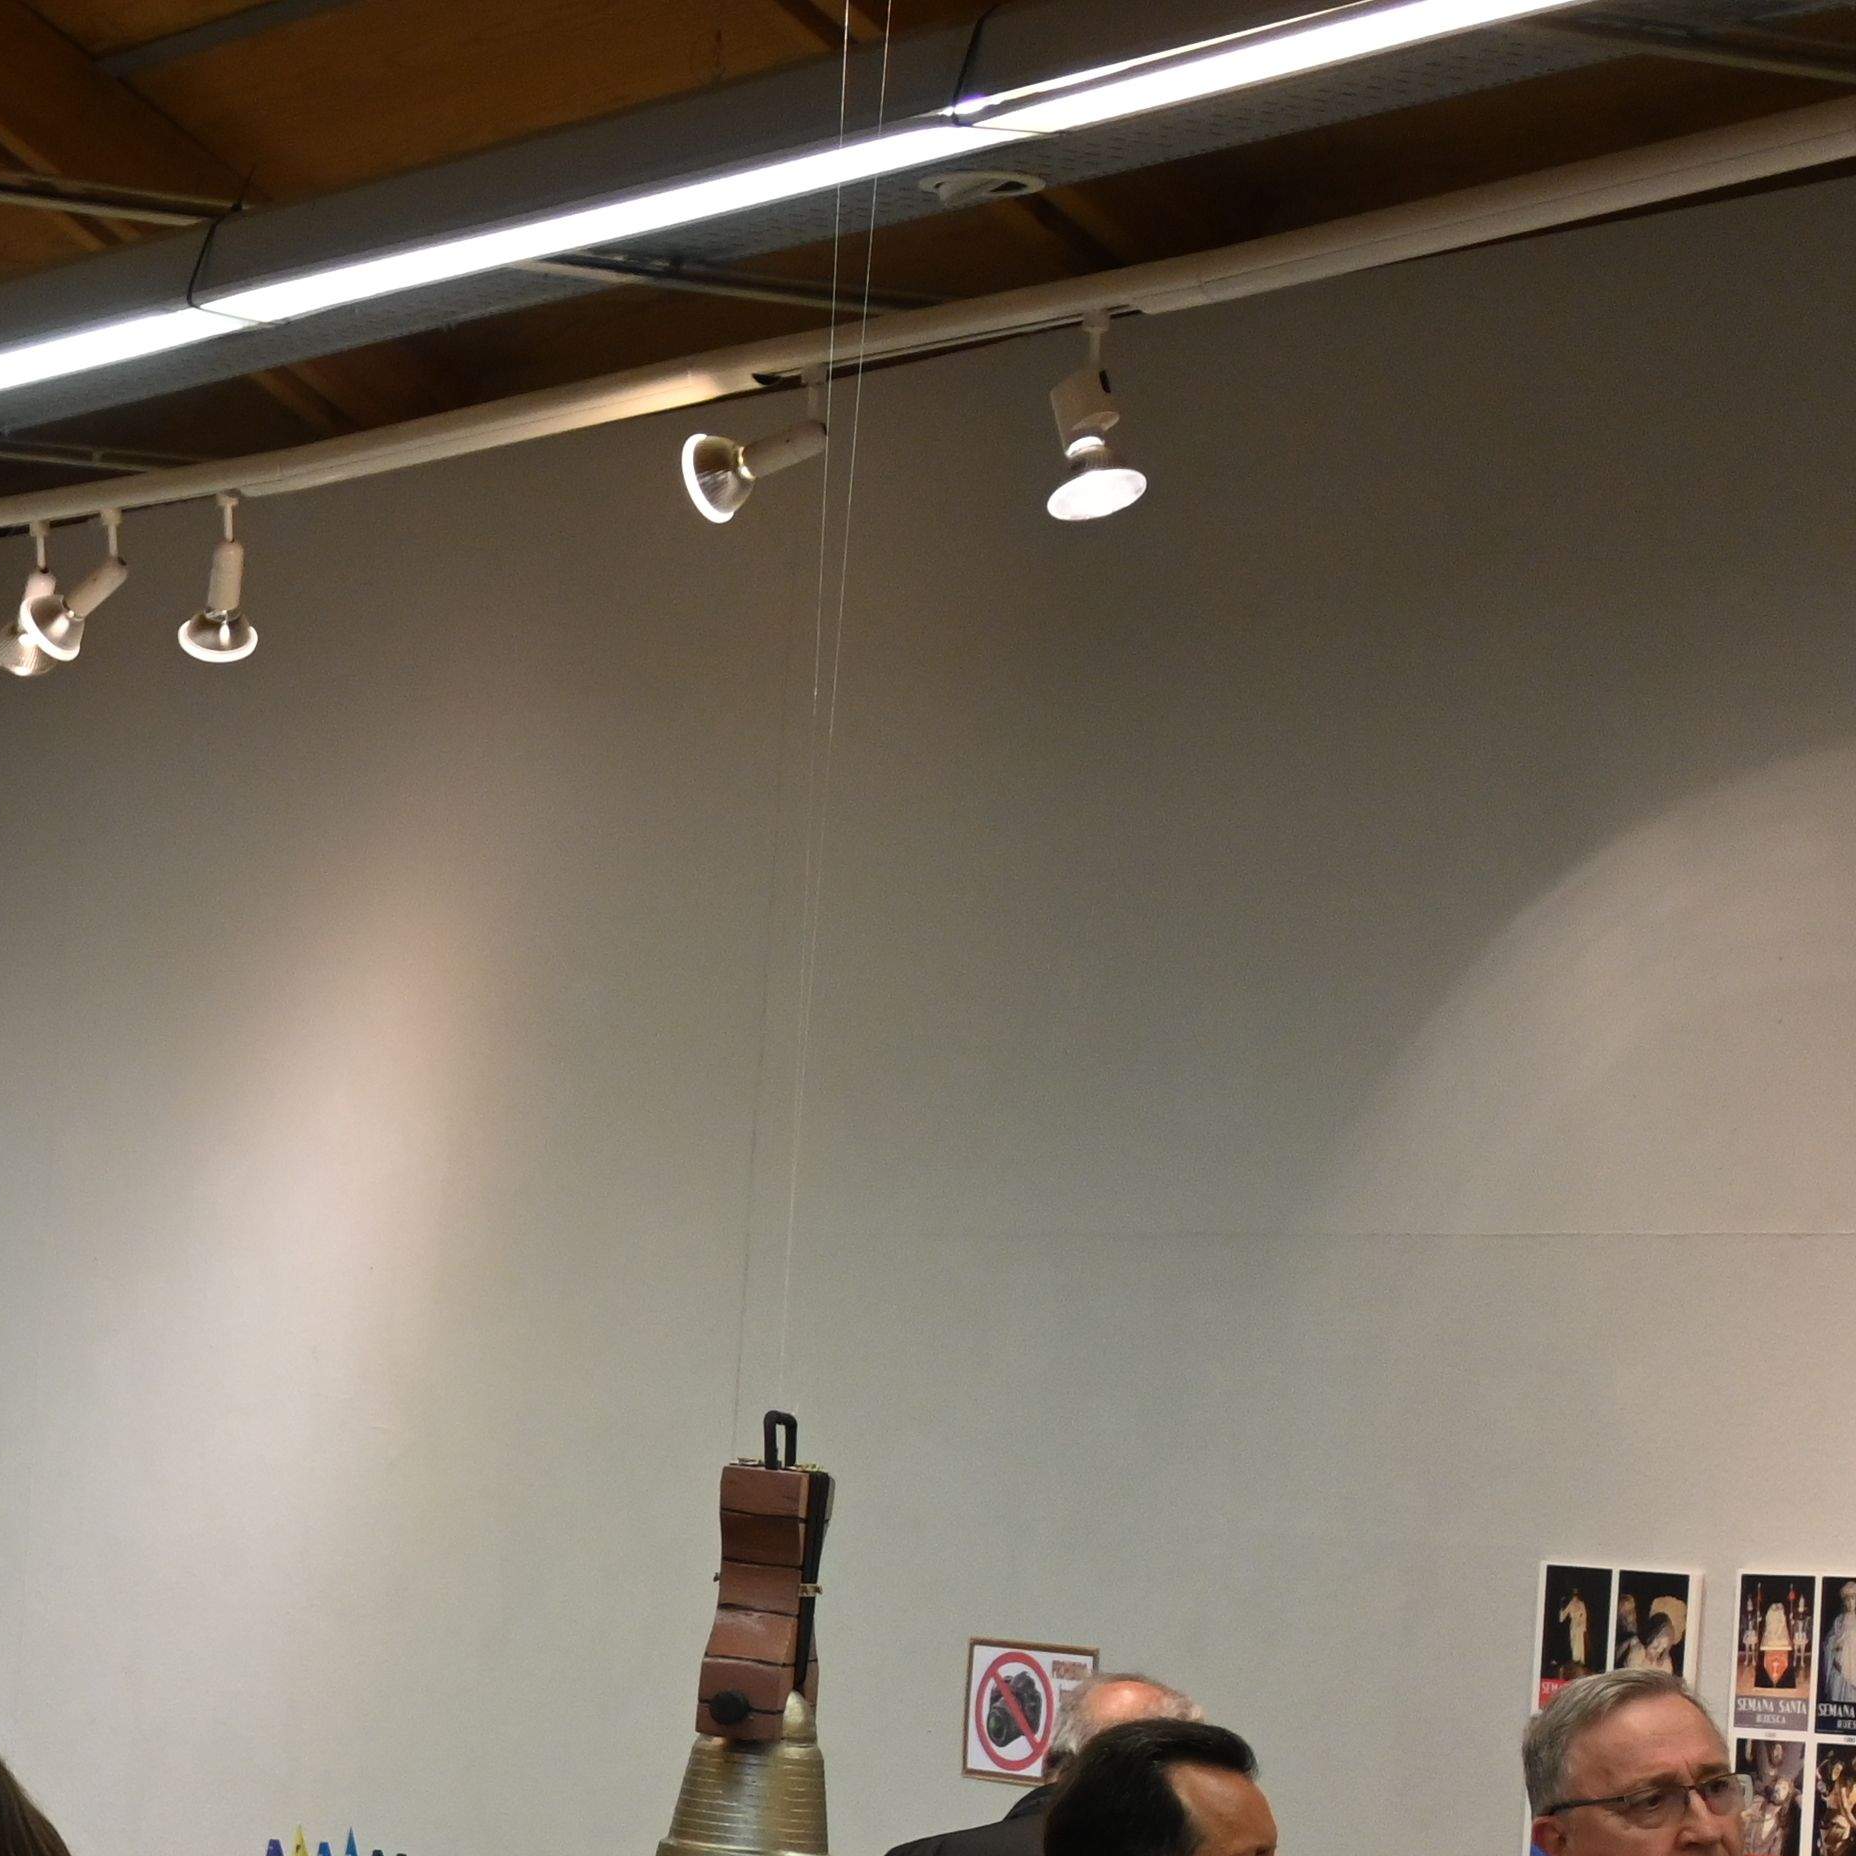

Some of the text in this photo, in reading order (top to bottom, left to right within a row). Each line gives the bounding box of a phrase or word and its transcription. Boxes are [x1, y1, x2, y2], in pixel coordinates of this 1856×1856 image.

[1737, 1697, 1808, 1715] SEMANA SANTA
[1817, 1702, 1856, 1718] SEMANA
